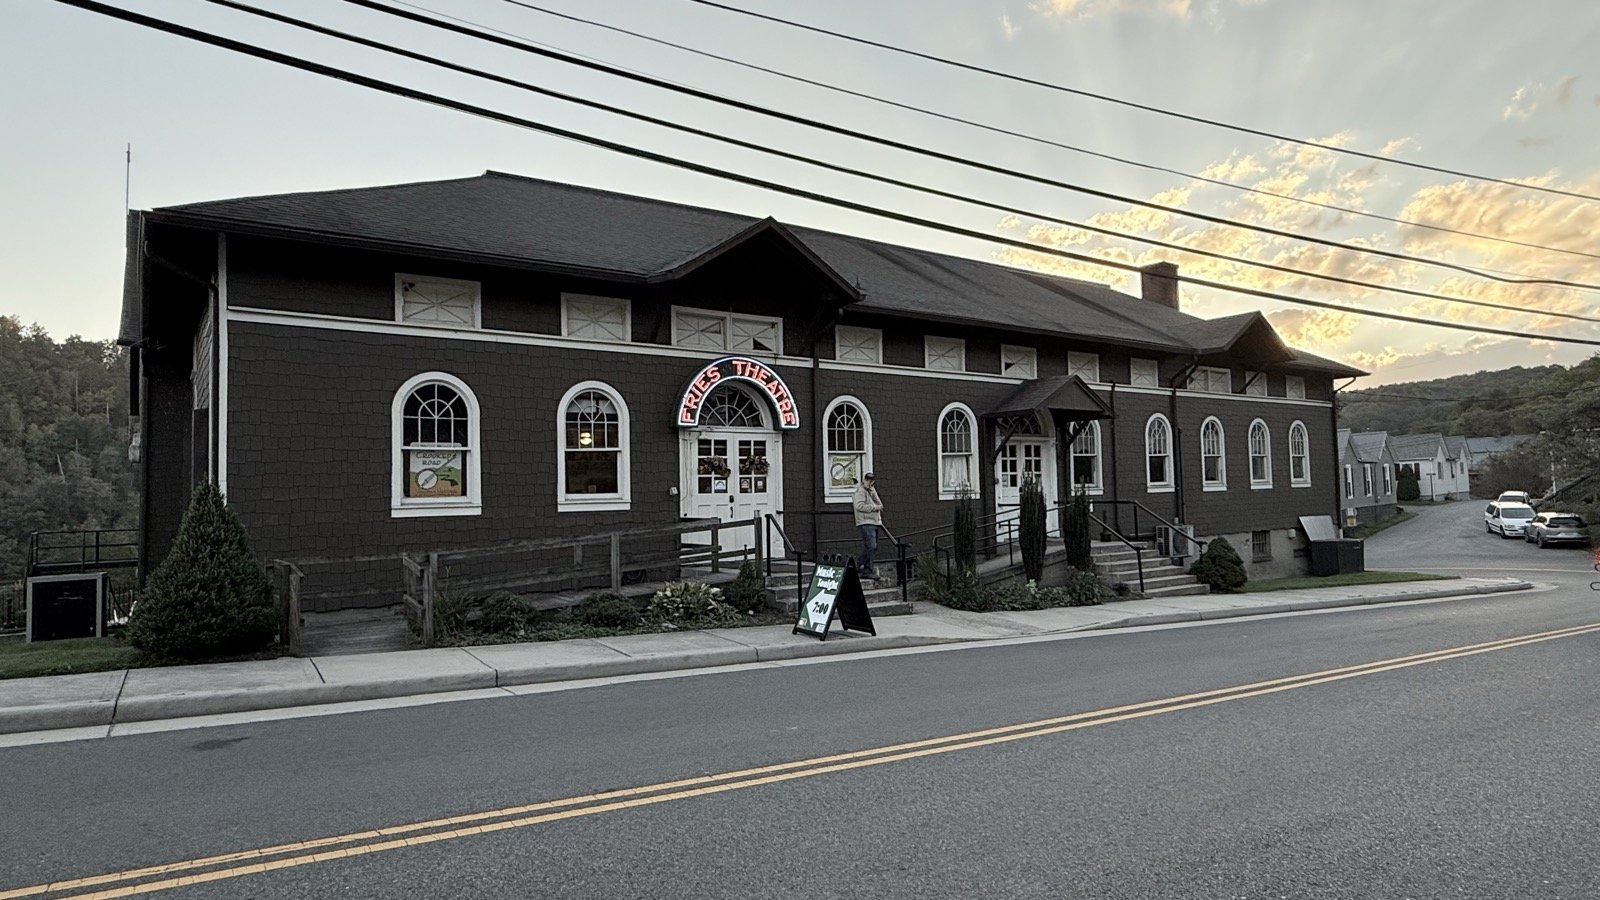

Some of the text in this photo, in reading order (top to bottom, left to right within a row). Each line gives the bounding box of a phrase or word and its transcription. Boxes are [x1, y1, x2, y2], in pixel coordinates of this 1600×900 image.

[681, 360, 796, 425] FRIES THEATRE
[816, 565, 836, 578] Music
[812, 601, 830, 615] 7:00
